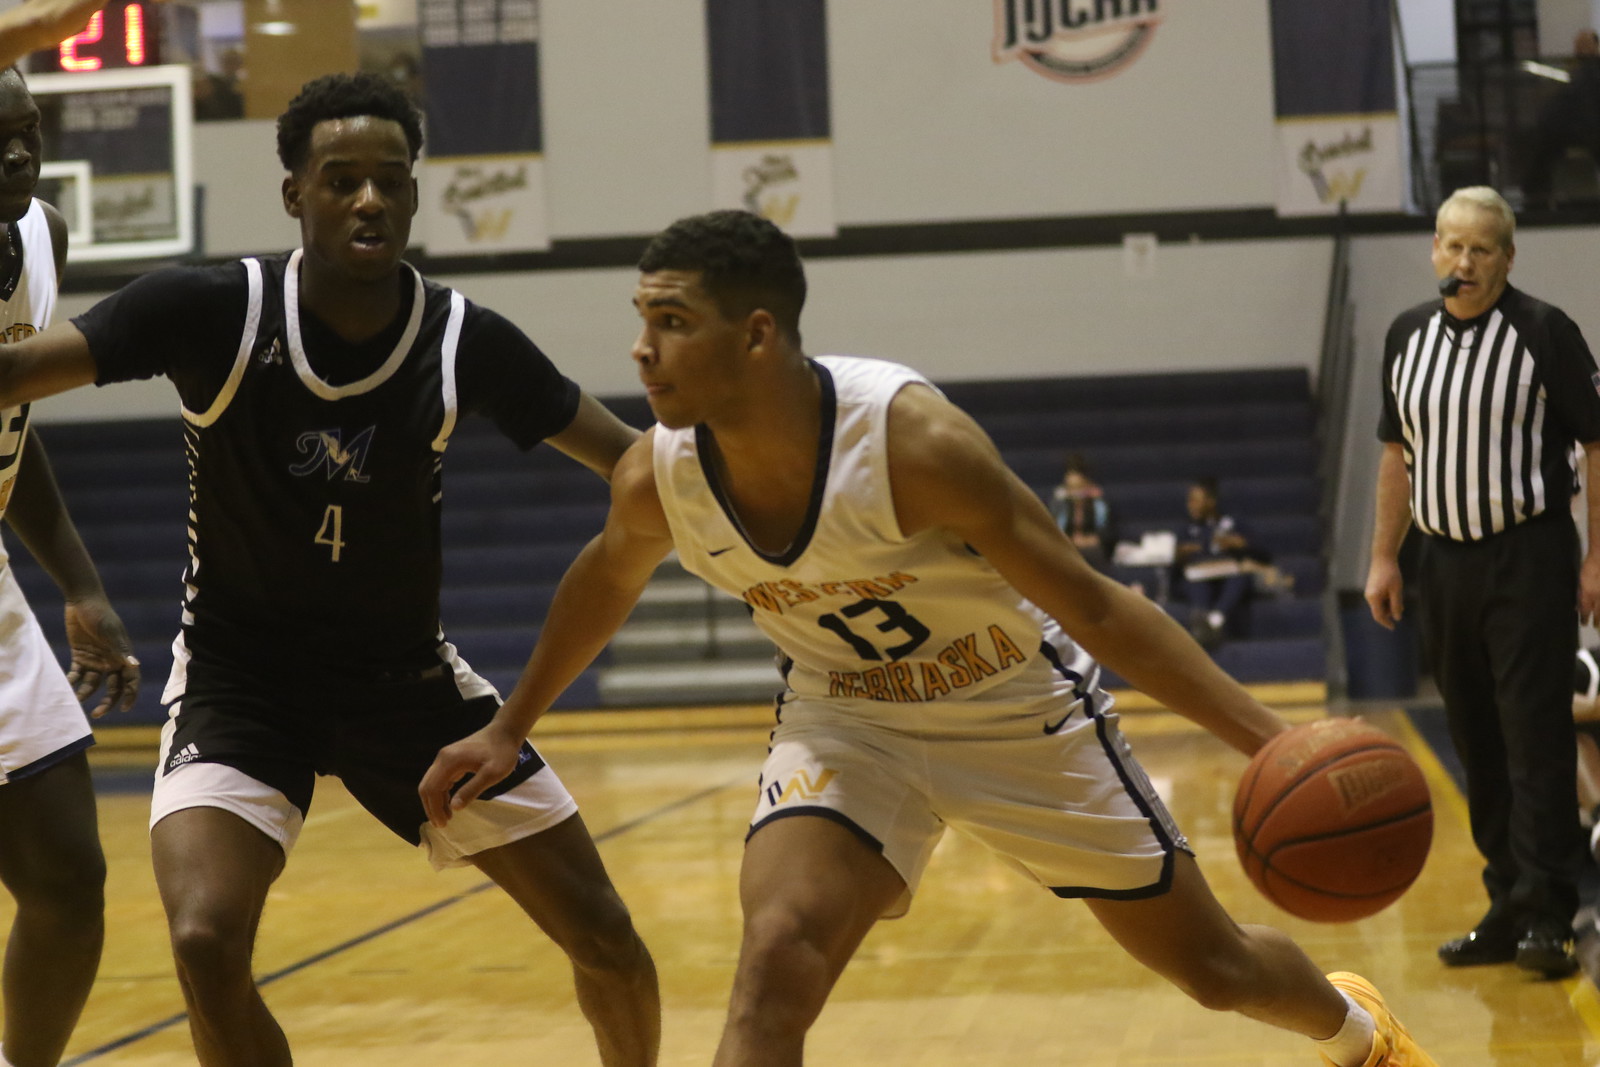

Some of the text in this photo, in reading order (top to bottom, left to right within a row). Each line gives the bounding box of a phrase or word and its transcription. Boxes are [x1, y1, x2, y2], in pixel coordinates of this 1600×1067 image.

[60, 3, 144, 72] 21
[289, 424, 376, 483] M
[314, 504, 346, 562] 4
[742, 571, 918, 615] WESERN
[818, 597, 931, 662] 13
[828, 623, 1027, 703] NEBRASKA
[169, 753, 202, 768] adida
